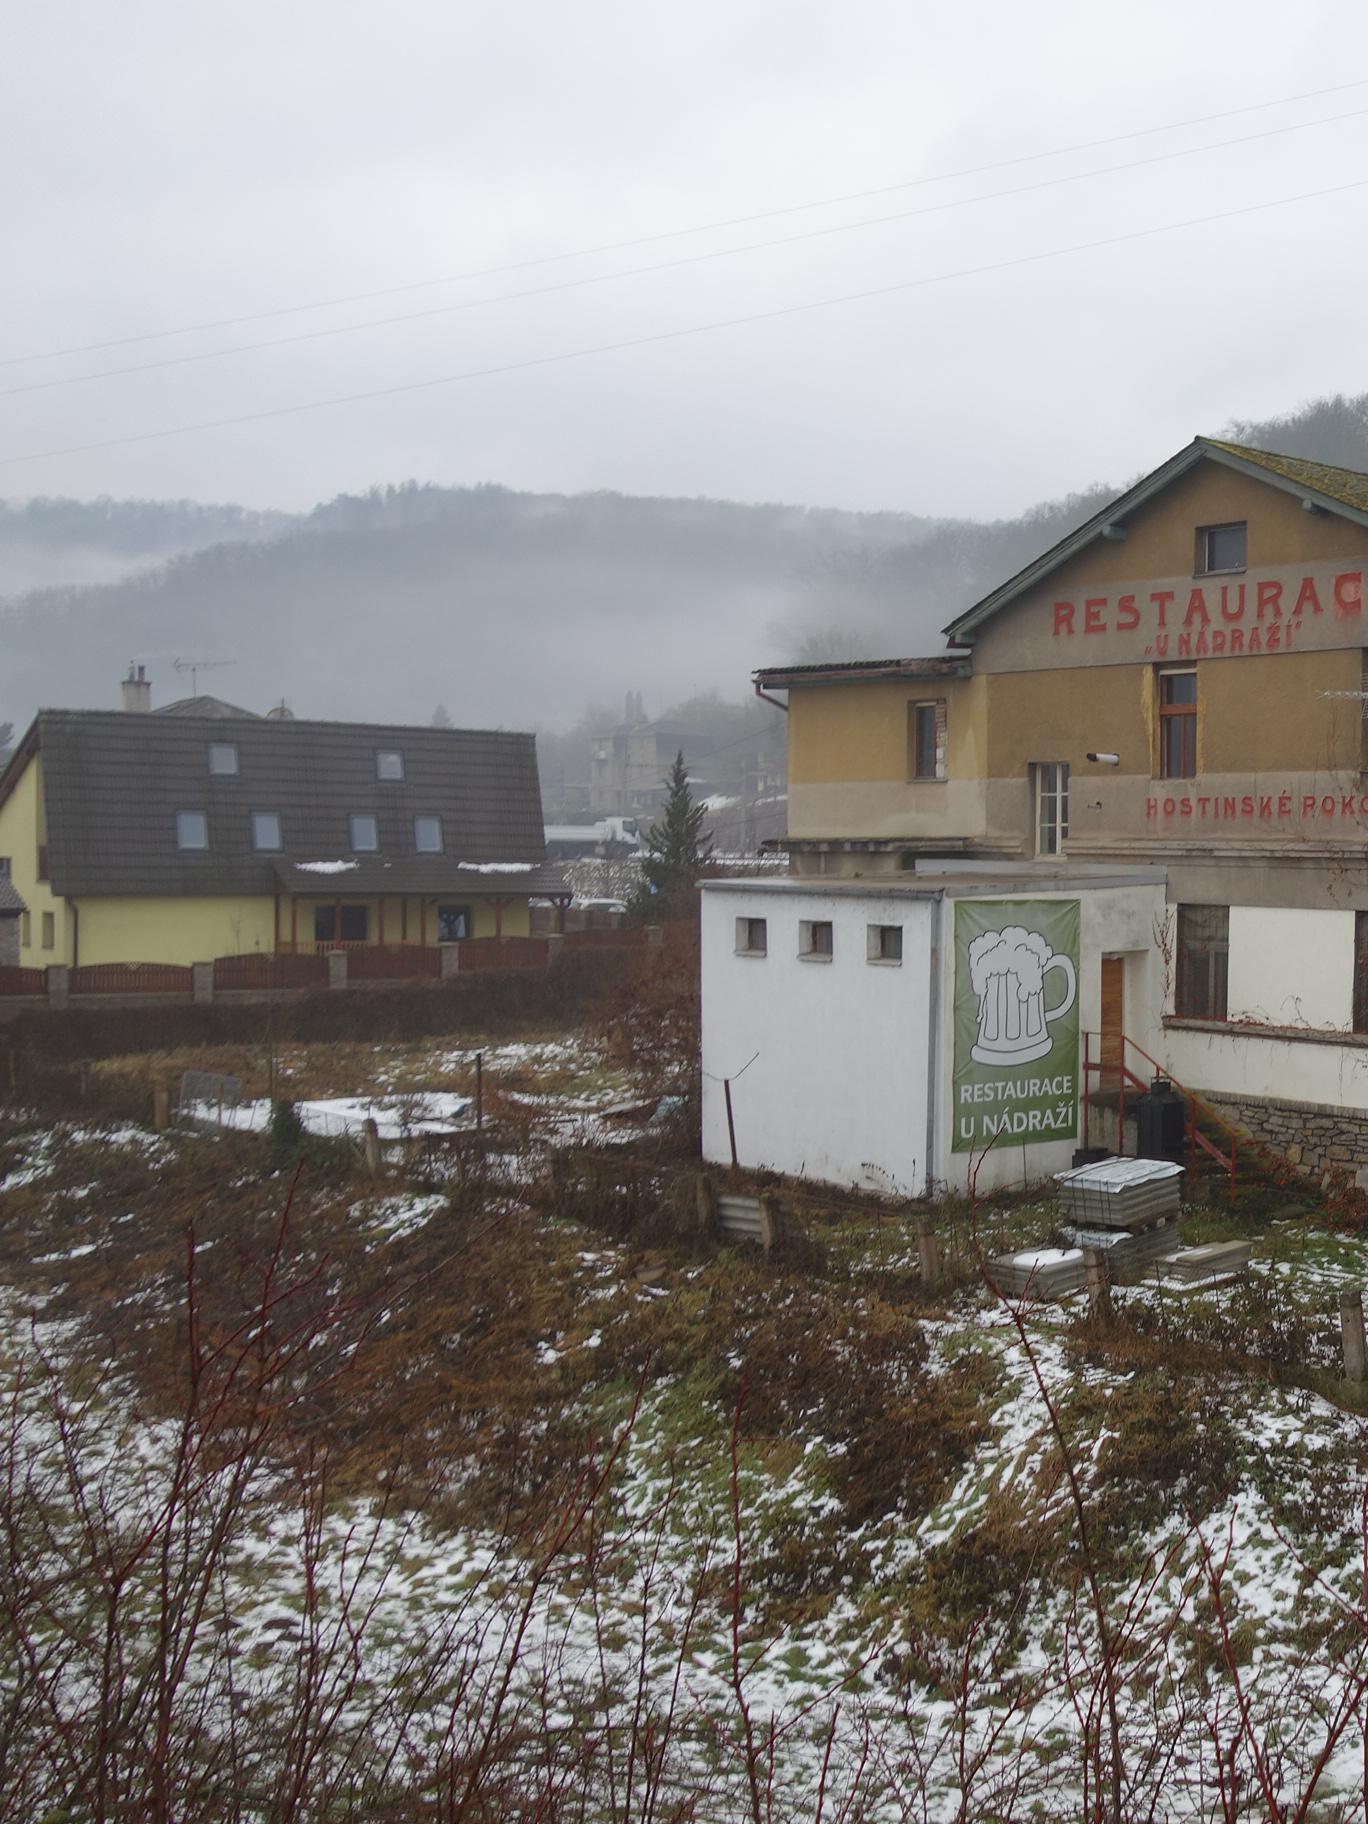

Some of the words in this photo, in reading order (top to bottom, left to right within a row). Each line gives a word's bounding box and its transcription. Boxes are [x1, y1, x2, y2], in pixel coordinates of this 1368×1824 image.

[1146, 790, 1293, 819] HOSTINSKÉ
[960, 1076, 1073, 1104] RESTAURACE
[960, 1116, 975, 1139] U
[983, 1100, 1074, 1137] NÁDRAŽÍ
